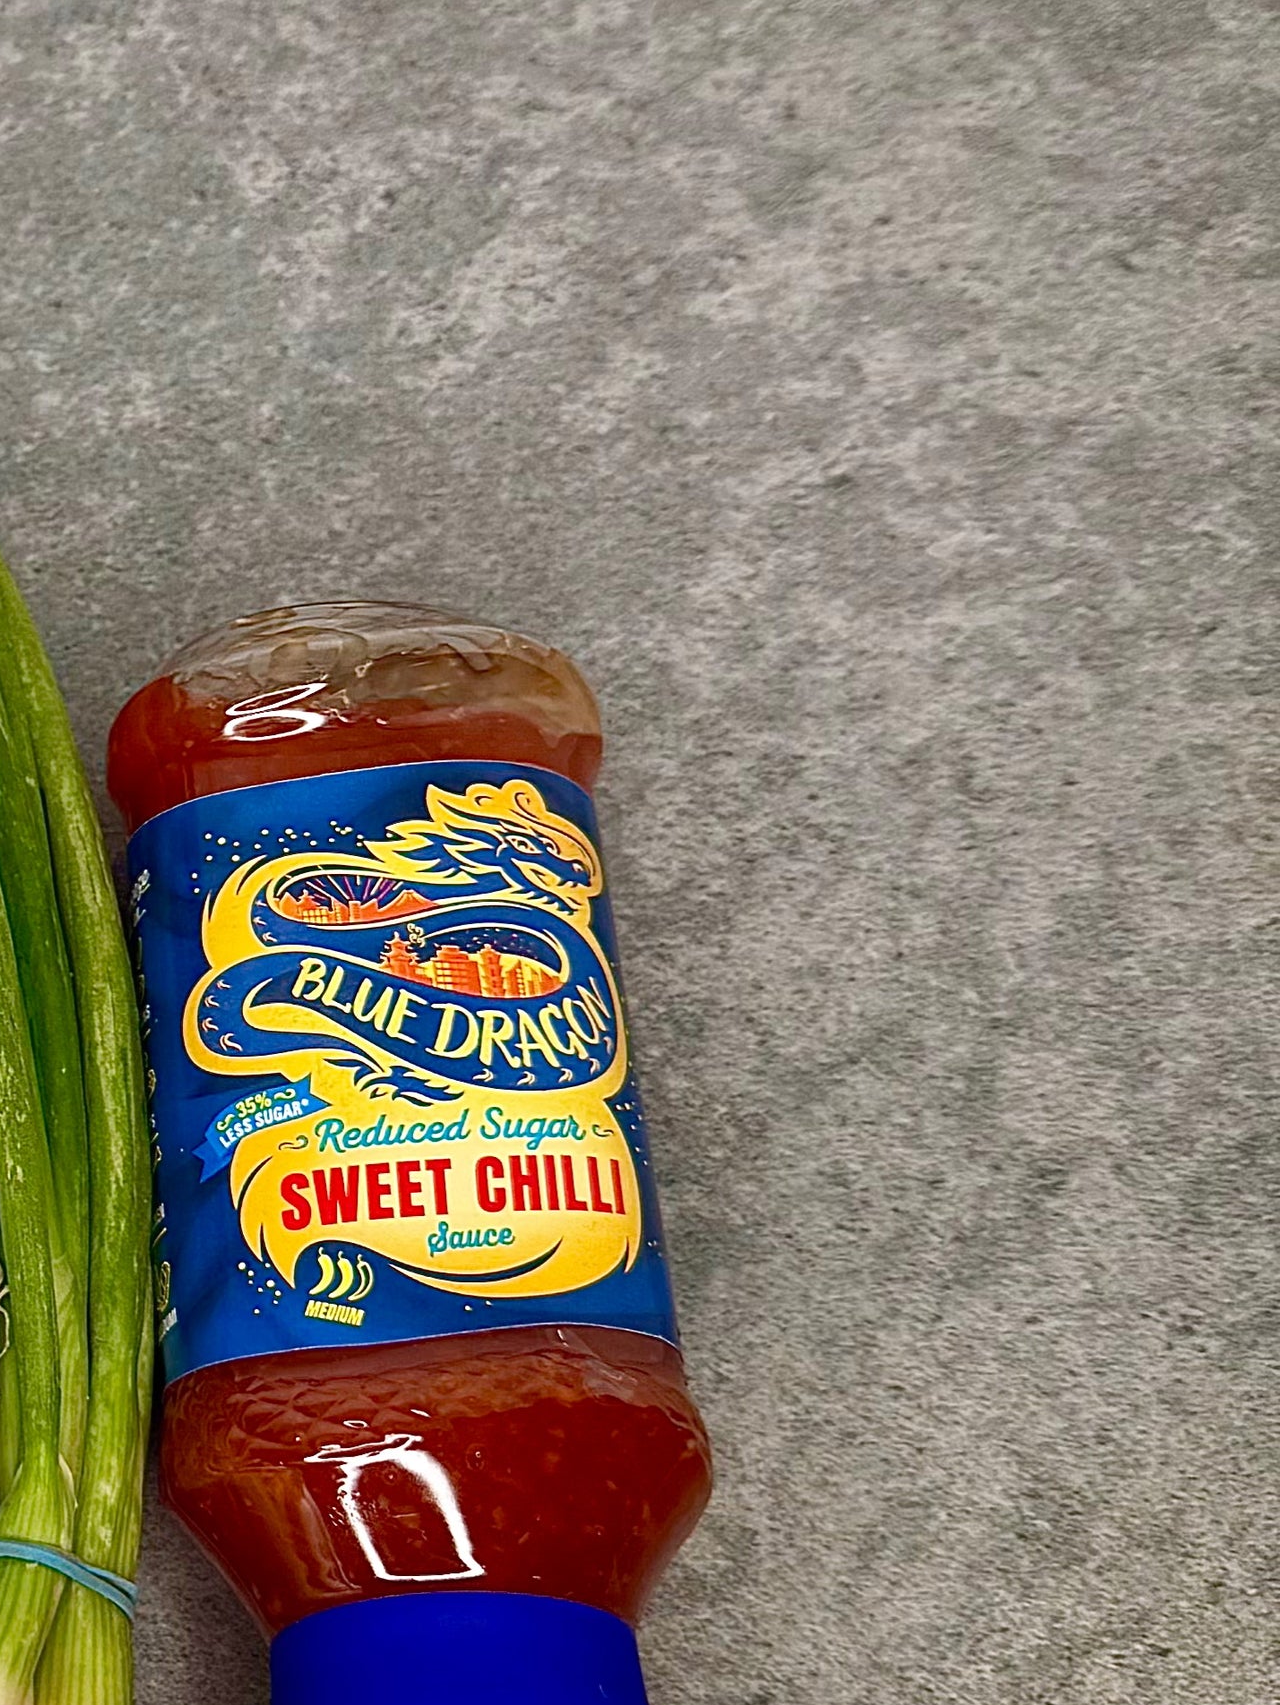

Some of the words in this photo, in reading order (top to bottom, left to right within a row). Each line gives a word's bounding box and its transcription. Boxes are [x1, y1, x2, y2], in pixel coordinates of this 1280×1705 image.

[291, 957, 419, 1044] BLUE
[425, 977, 613, 1070] DRAGON
[235, 1091, 272, 1118] 35%
[219, 1118, 253, 1148] LESS
[314, 1109, 473, 1154] Reduced
[480, 1107, 587, 1151] Sugar
[280, 1158, 451, 1231] SWEET
[475, 1154, 627, 1215] CHILLI
[427, 1222, 515, 1257] Sauce
[304, 1300, 366, 1327] MEDIUM
